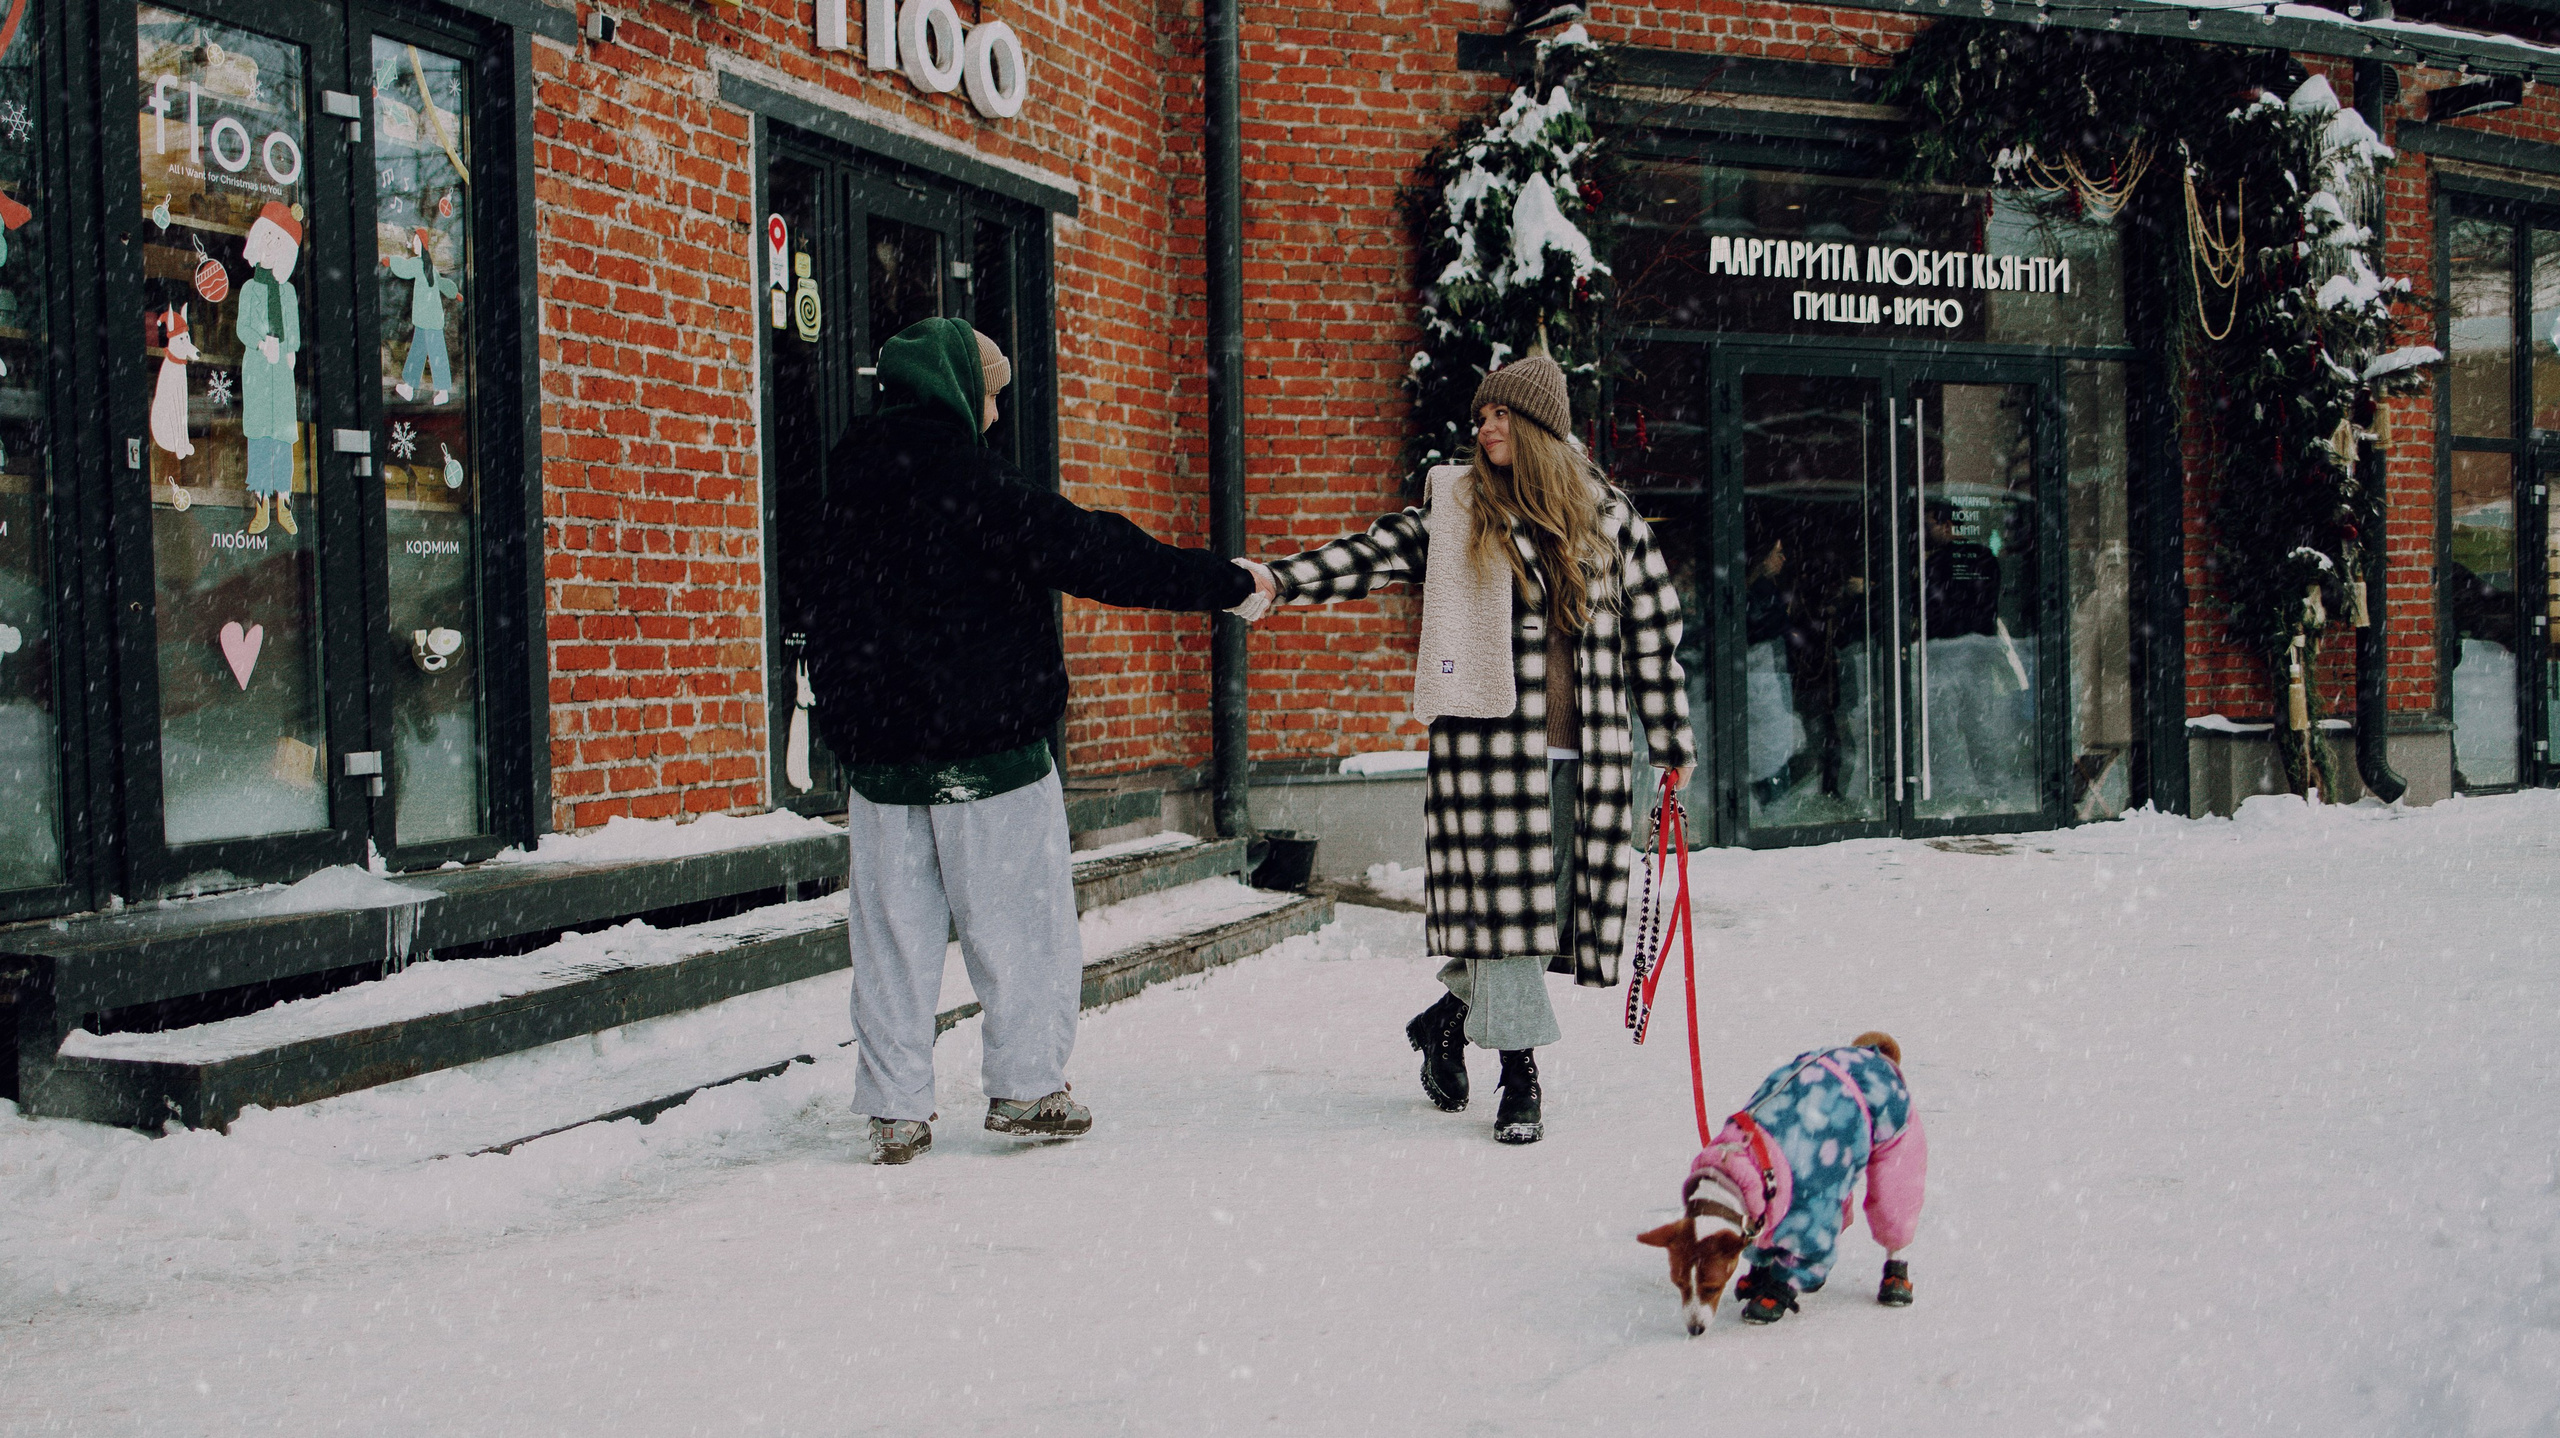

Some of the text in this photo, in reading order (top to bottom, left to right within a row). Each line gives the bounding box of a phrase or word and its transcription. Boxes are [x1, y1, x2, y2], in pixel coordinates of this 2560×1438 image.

[149, 74, 302, 185] floo
[168, 163, 180, 176] All
[181, 166, 185, 175] I
[186, 167, 206, 181] Want
[208, 171, 219, 183] for
[220, 174, 259, 192] Christmas
[268, 184, 283, 196] You
[1709, 235, 2071, 294] МАРГАРИТА ЛЮБИТ КЬЯНТИ
[211, 529, 268, 550] любим
[406, 540, 460, 559] кормим
